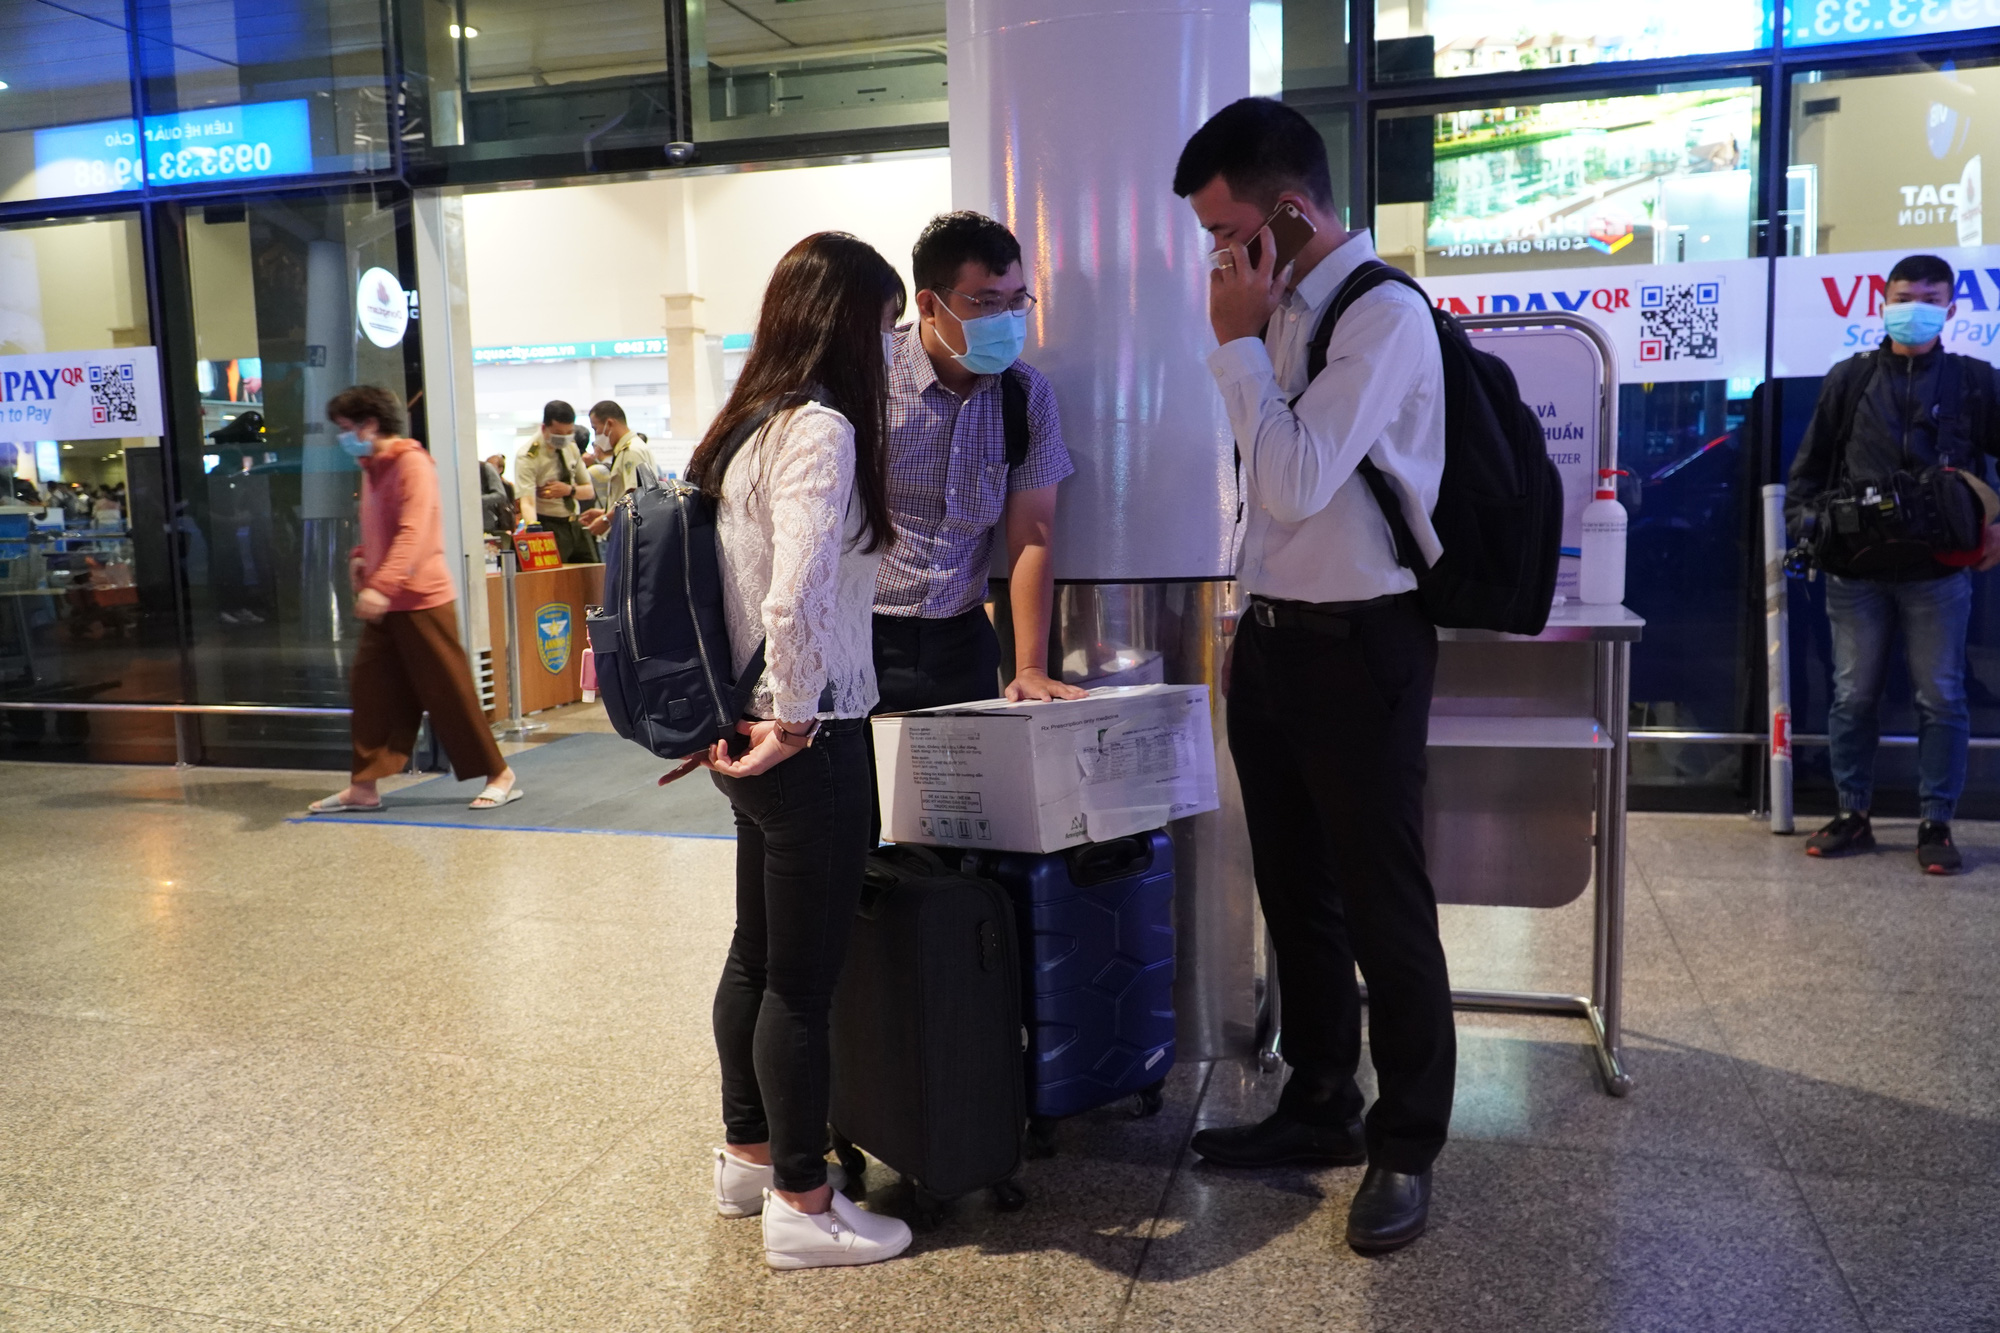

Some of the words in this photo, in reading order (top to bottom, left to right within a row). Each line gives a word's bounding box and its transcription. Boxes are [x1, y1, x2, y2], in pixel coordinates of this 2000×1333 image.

[1592, 288, 1631, 313] QR
[1843, 324, 1889, 347] Sca
[1950, 319, 2000, 347] Pay
[474, 344, 576, 361] aquacity.com.vn
[0, 368, 60, 403] PAY
[61, 367, 85, 386] QR
[9, 407, 22, 423] to
[26, 405, 52, 424] Pay
[1537, 401, 1557, 418] VÀ
[1542, 421, 1584, 441] HUẨN
[1549, 453, 1581, 465] TIZER
[1050, 720, 1083, 730] Prescription
[1095, 713, 1119, 722] medicine
